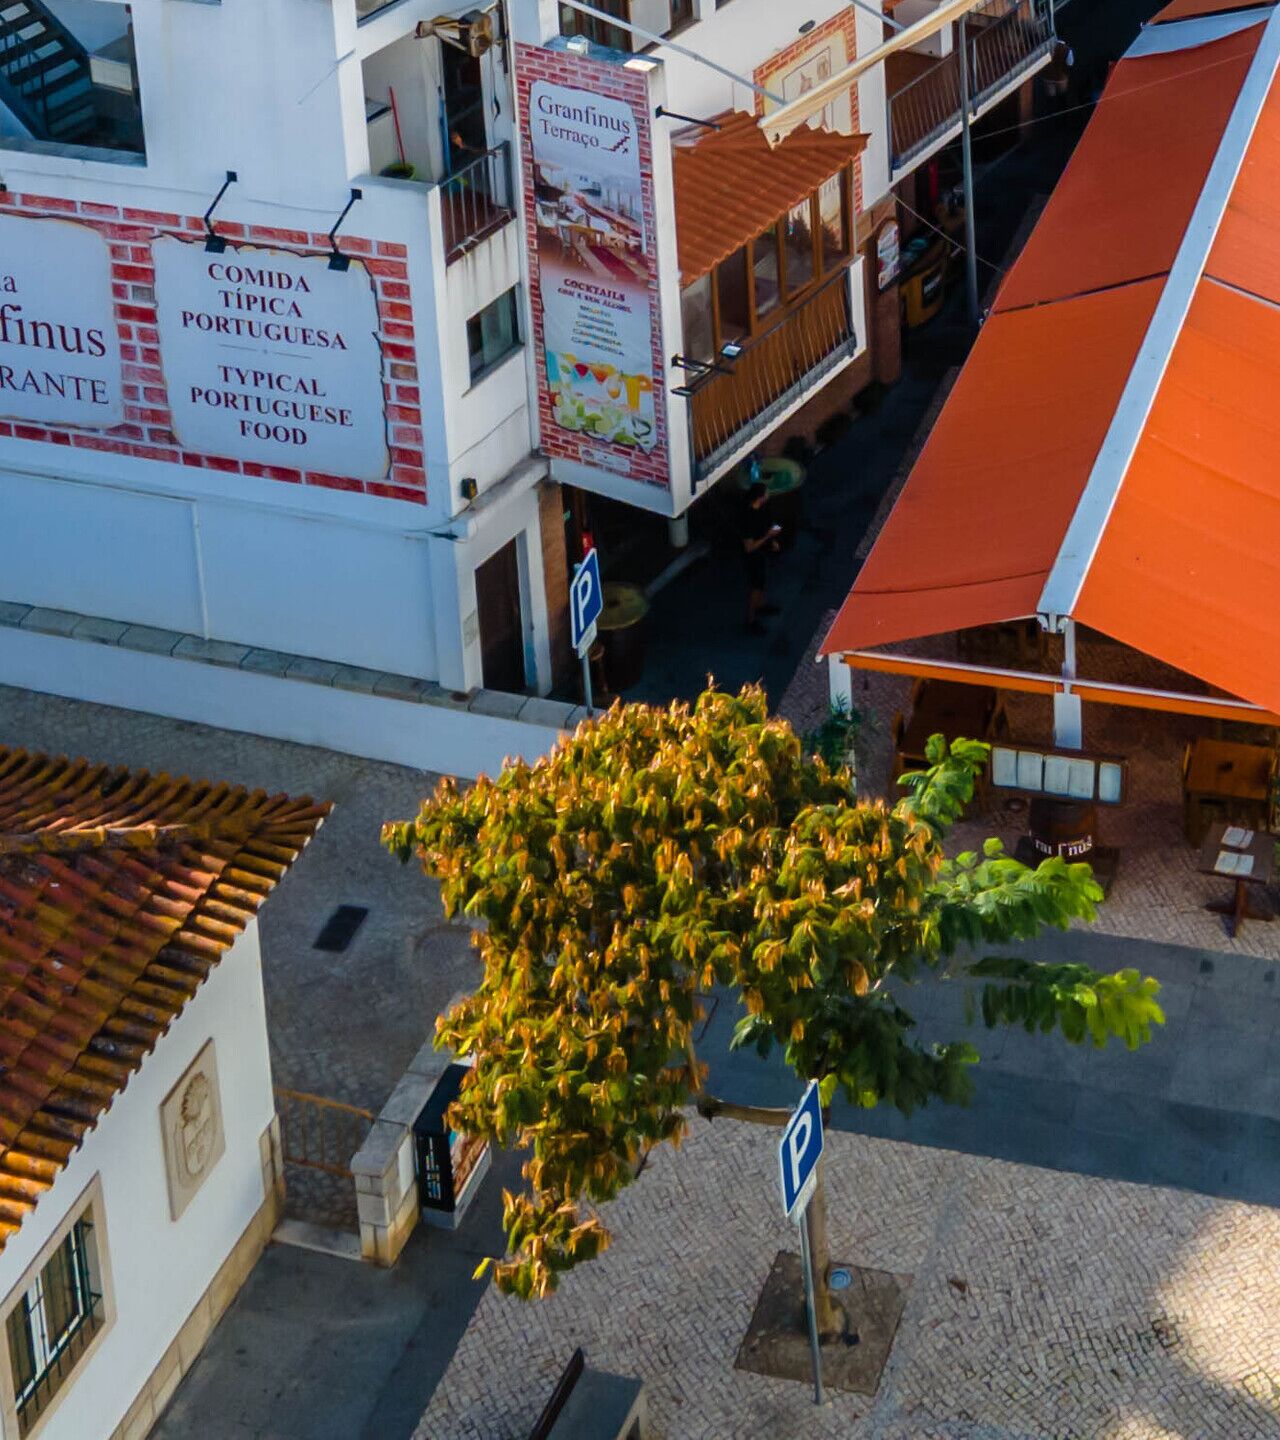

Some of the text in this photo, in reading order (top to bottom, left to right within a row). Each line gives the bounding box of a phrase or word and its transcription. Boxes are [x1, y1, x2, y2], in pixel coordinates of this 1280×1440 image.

[537, 94, 630, 135] Granfinus
[539, 119, 599, 148] Terraço
[208, 263, 311, 293] COMIDA
[563, 278, 626, 302] COCKTAILS
[218, 288, 303, 319] TÍPICA
[181, 311, 348, 350] PORTUGUESA
[217, 365, 326, 397] TYPICAL
[190, 386, 353, 427] PORTUGUESE
[240, 420, 308, 446] FOOD
[578, 571, 592, 633] P
[789, 1111, 812, 1194] P
